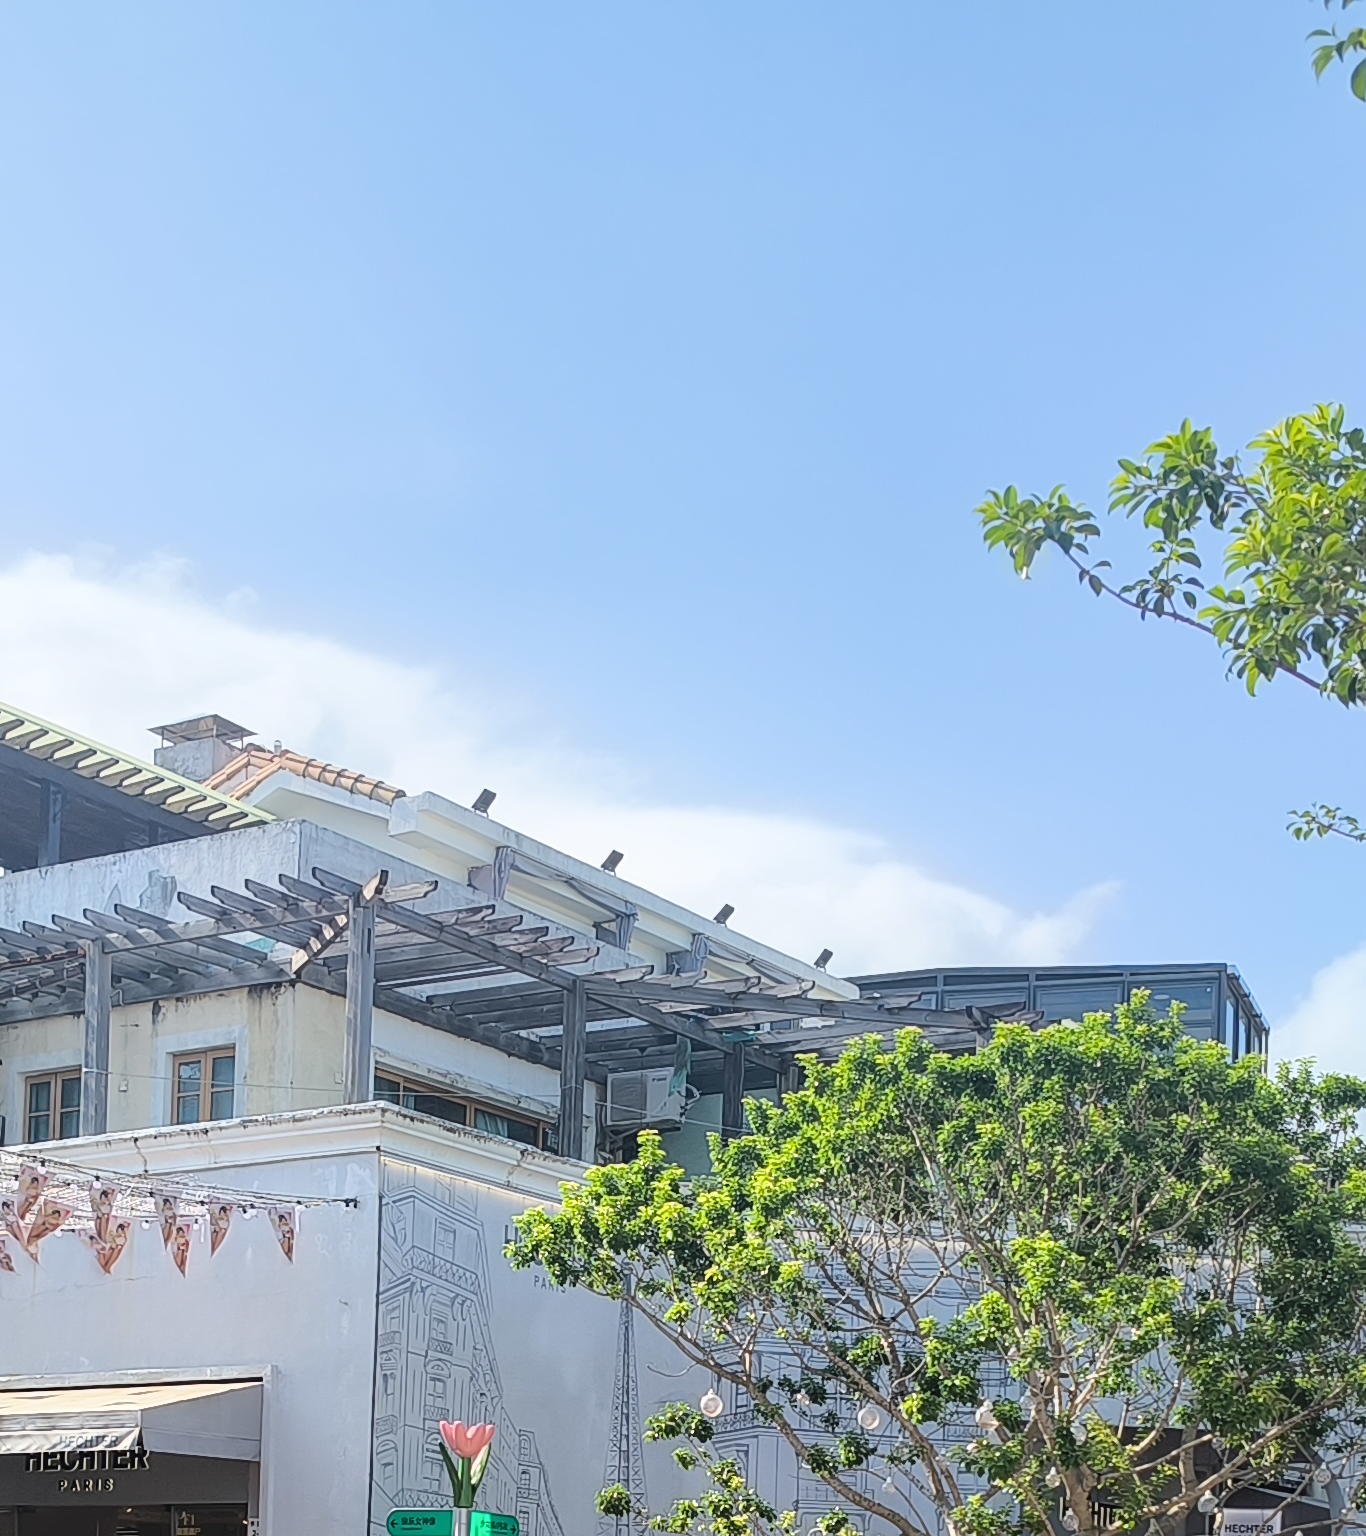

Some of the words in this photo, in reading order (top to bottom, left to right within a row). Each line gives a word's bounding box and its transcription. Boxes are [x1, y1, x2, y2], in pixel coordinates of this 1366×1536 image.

[25, 1447, 150, 1473] HECHTER
[58, 1478, 115, 1492] PARIS
[1224, 1524, 1274, 1534] HECHTER
